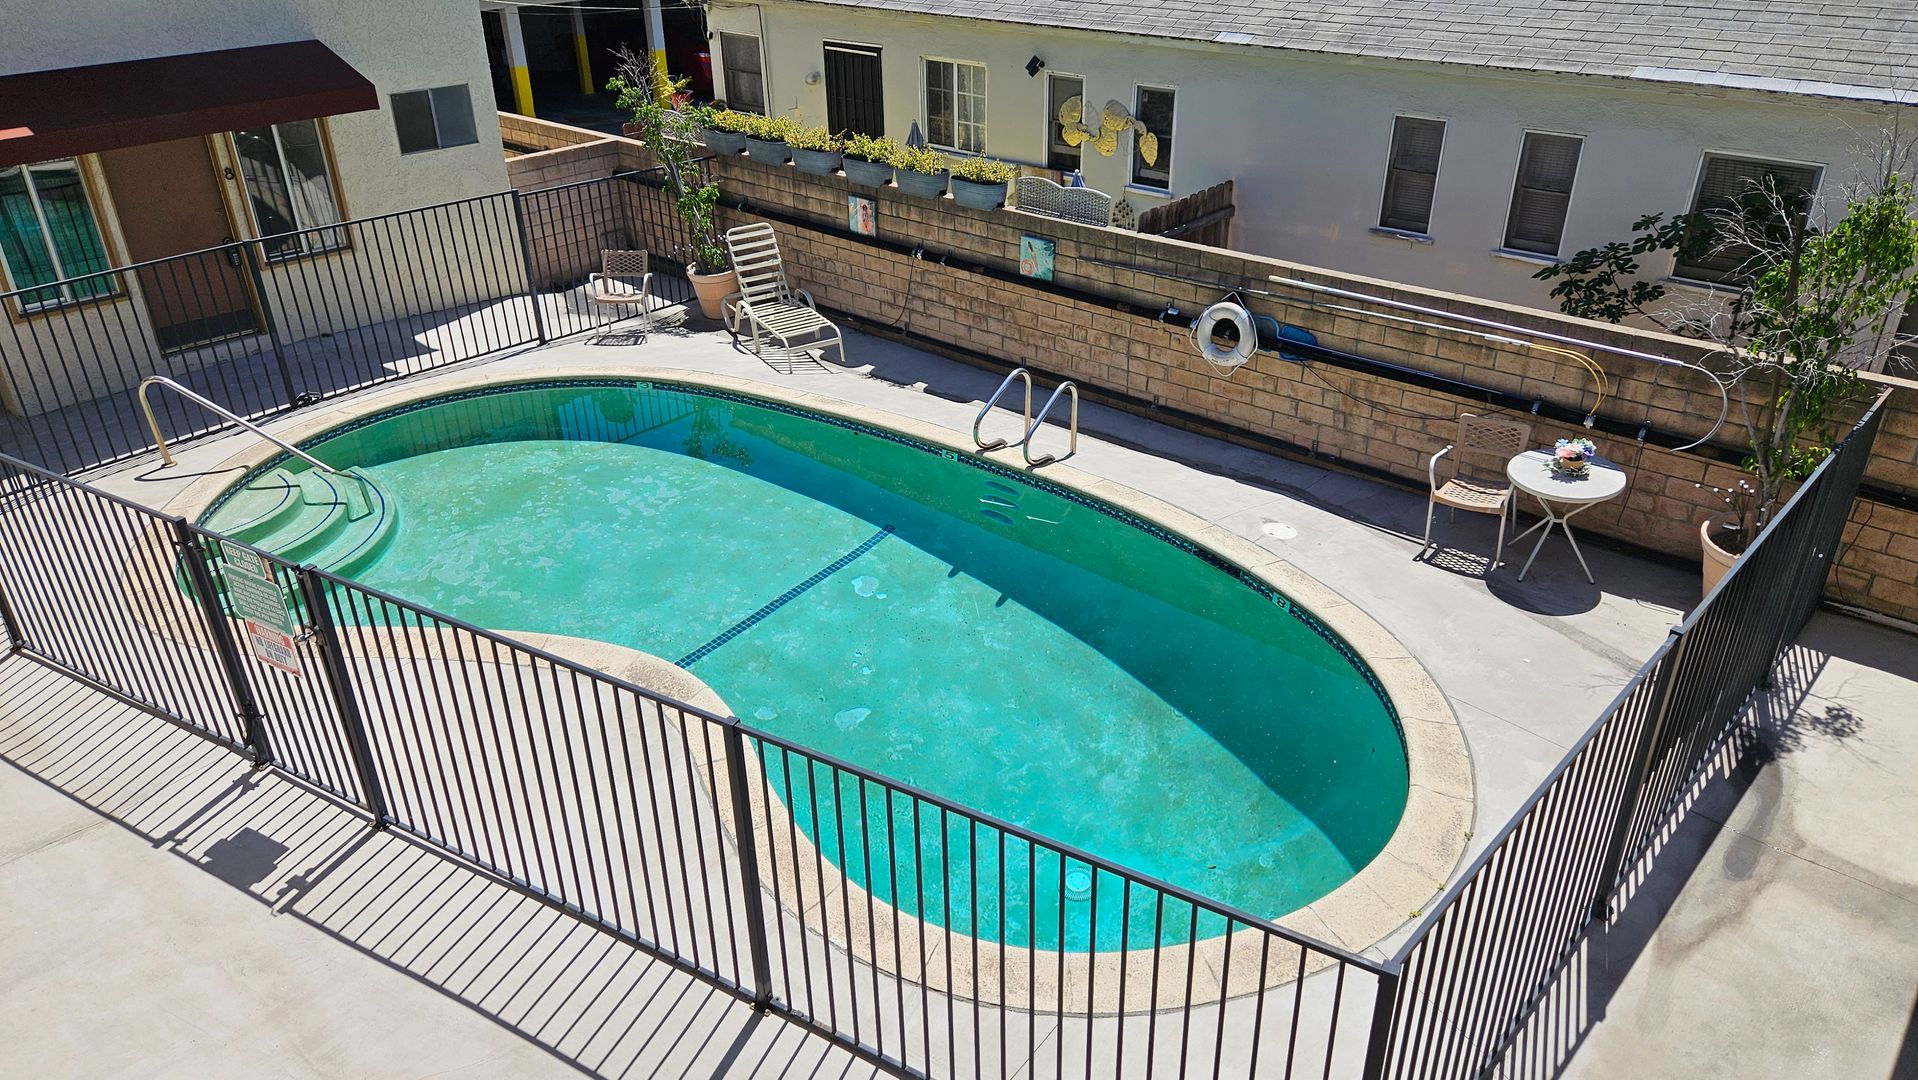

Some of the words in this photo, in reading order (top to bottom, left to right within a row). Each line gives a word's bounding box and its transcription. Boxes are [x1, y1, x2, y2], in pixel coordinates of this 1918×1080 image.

[224, 167, 235, 180] 8
[945, 451, 954, 460] 5
[223, 545, 242, 559] KEEP
[242, 551, 260, 565] GATE
[233, 557, 259, 573] CLOSED
[1276, 597, 1287, 608] 8
